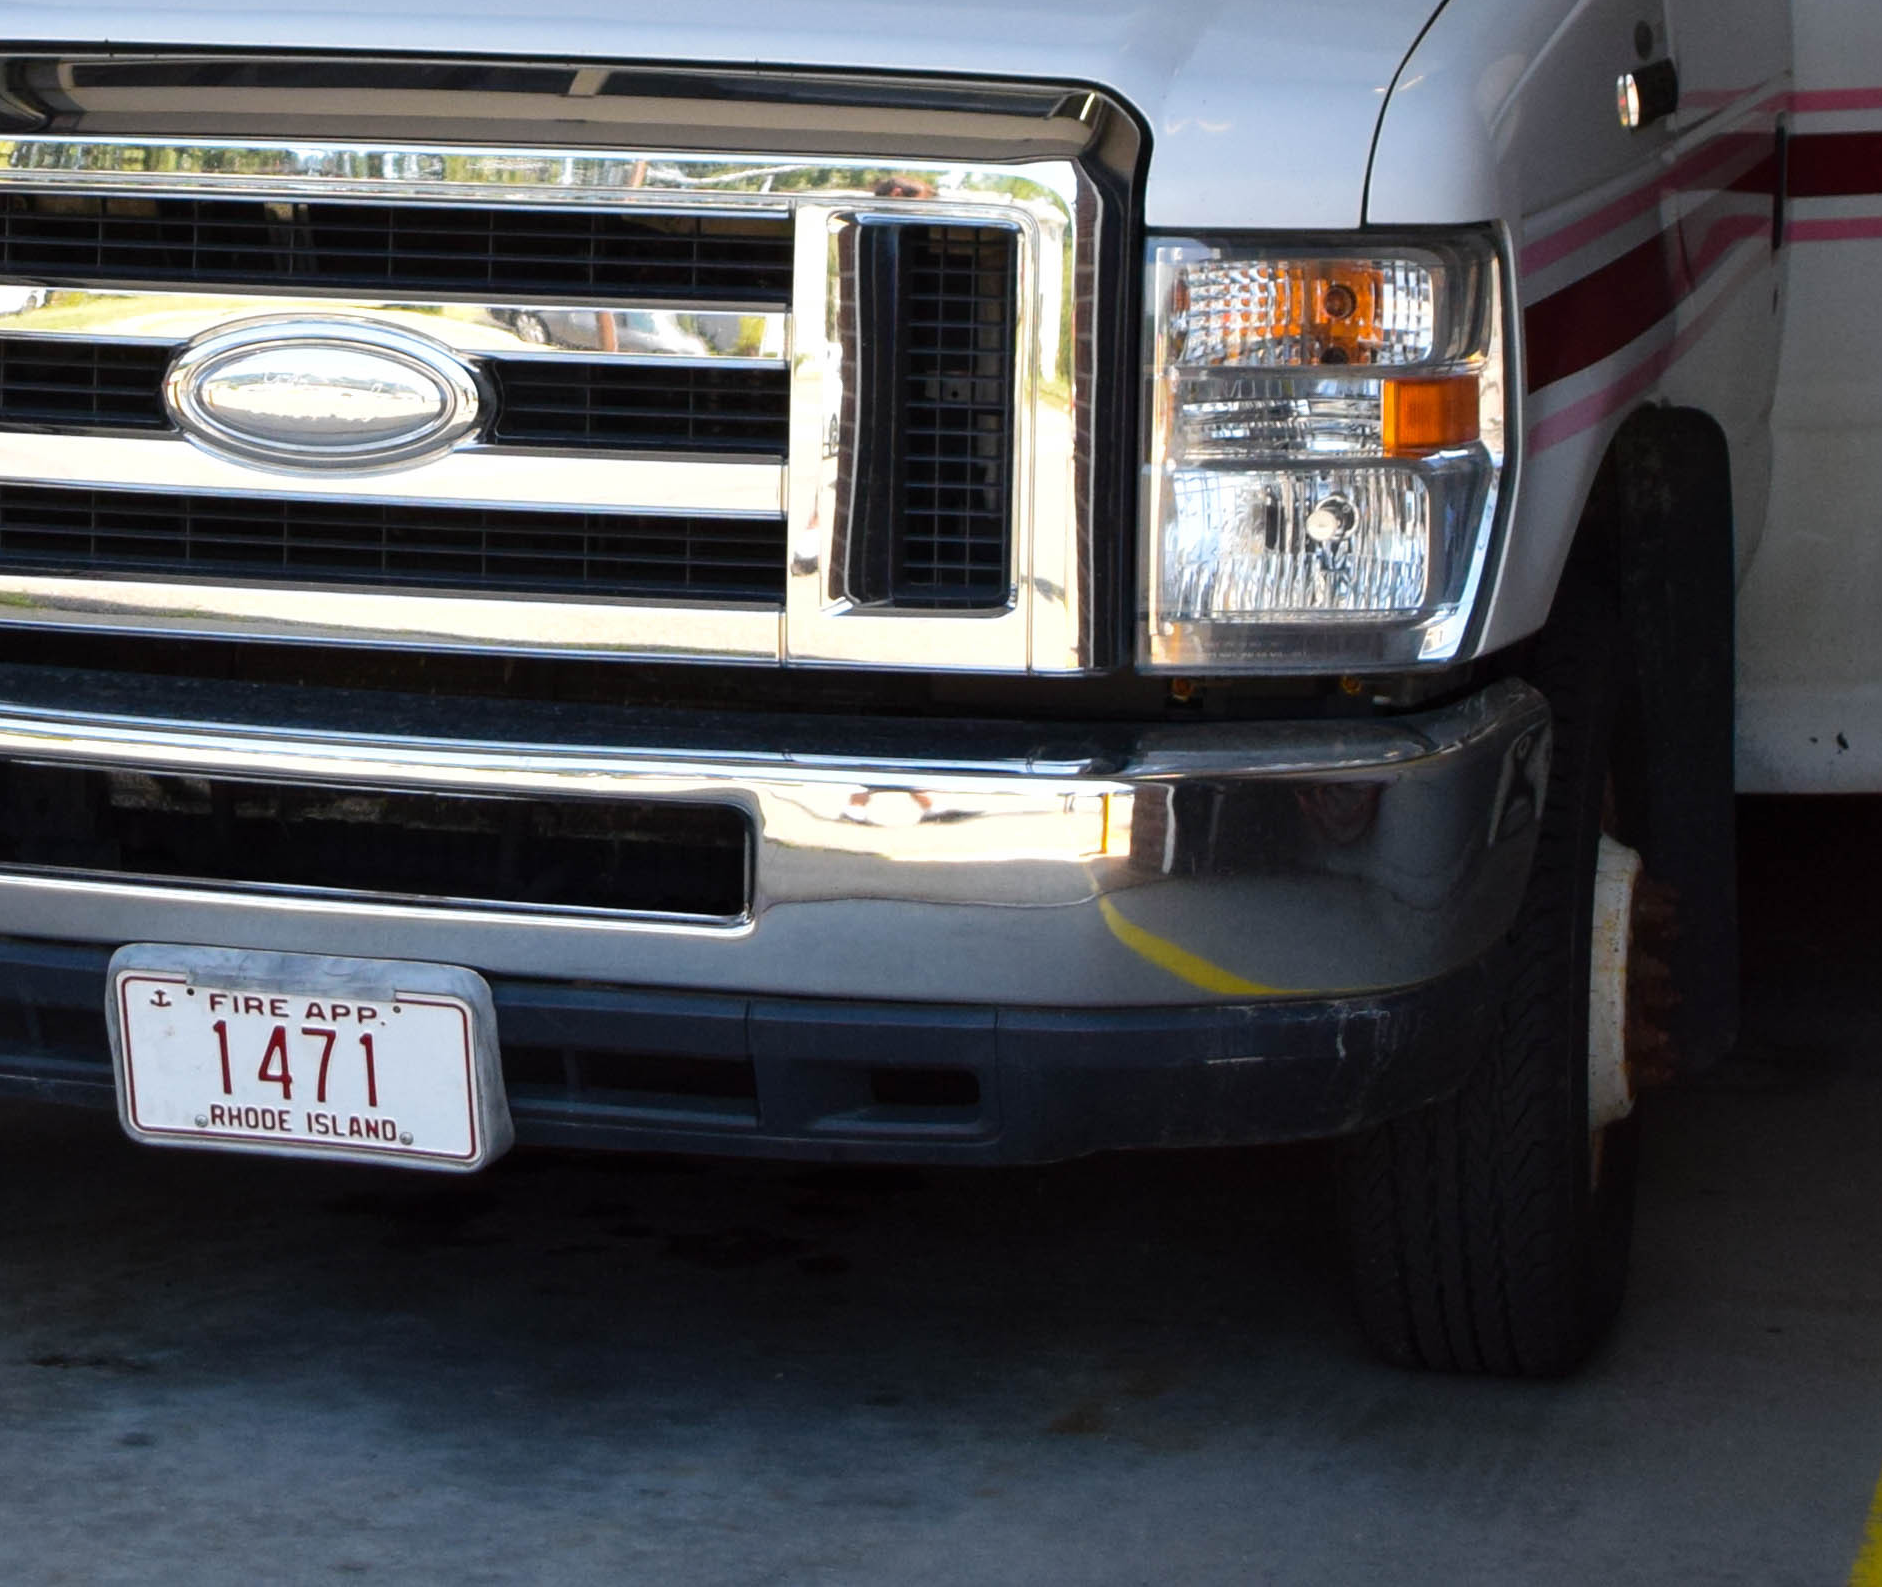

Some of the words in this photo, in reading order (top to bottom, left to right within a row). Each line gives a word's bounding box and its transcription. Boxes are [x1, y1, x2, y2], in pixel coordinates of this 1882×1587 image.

[209, 992, 290, 1019] FIRE
[305, 1001, 386, 1026] APP.
[213, 1019, 378, 1107] 1471
[210, 1103, 292, 1132] RHODE
[307, 1111, 397, 1142] ISLAND
